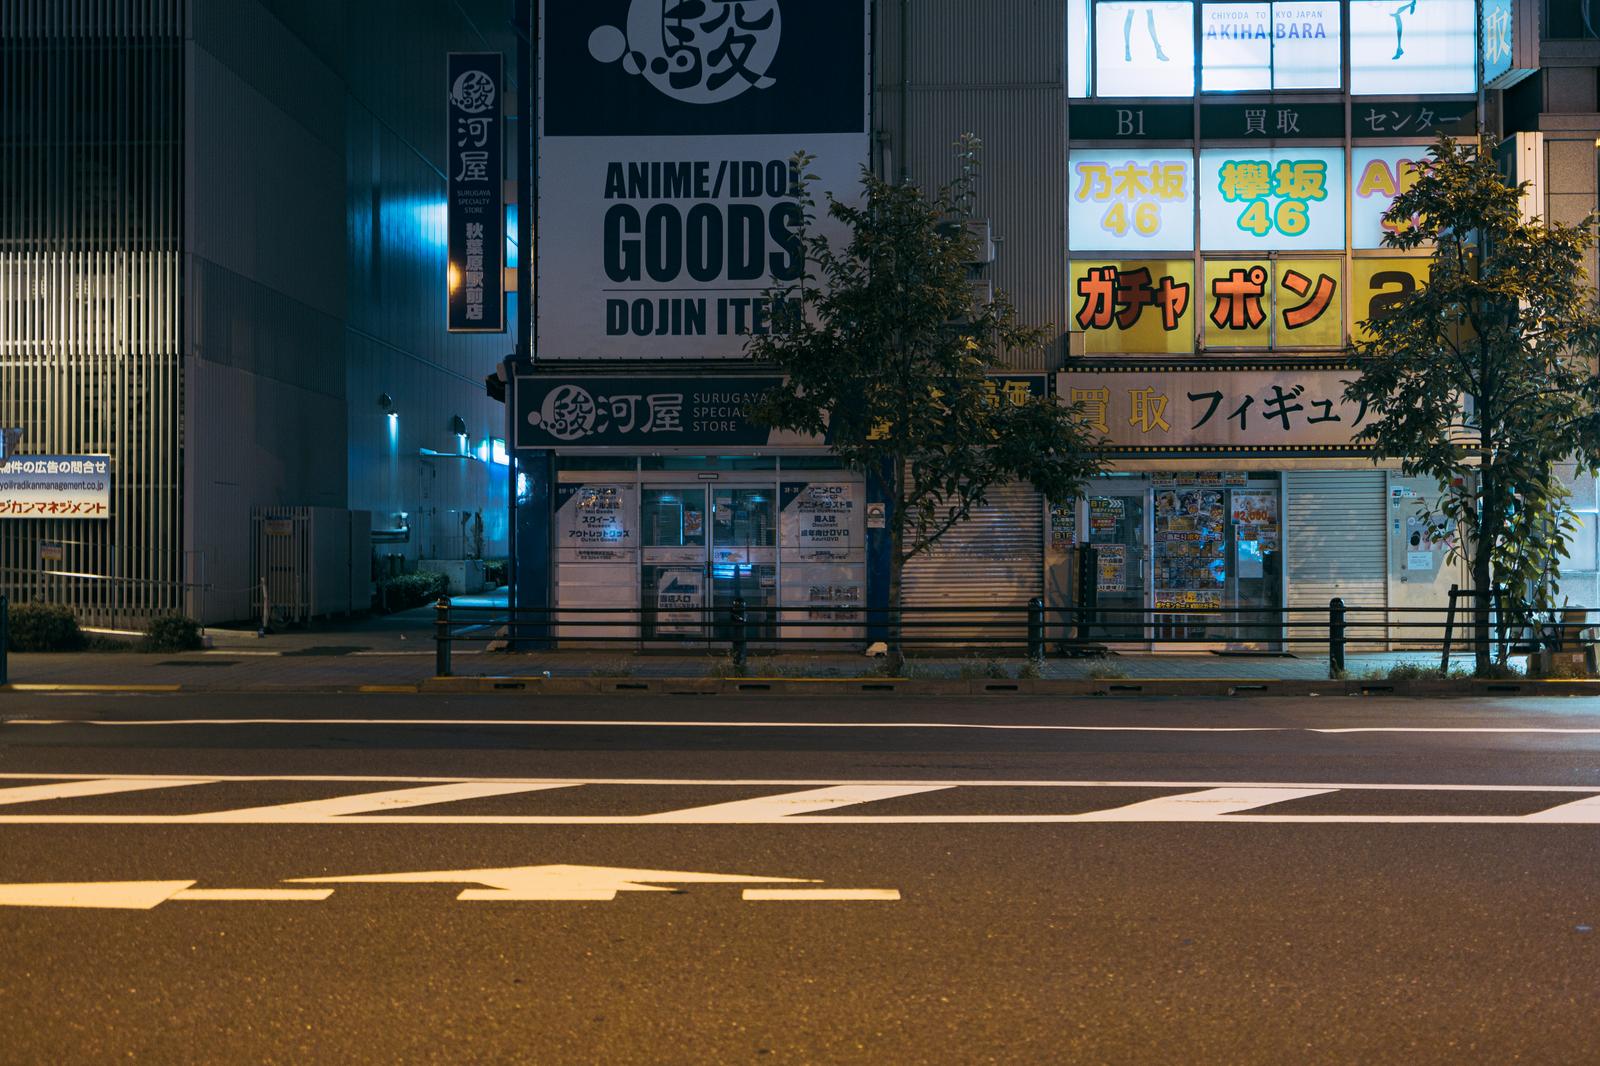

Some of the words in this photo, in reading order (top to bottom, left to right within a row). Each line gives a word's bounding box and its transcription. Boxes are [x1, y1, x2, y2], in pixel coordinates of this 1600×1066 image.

[1211, 11, 1249, 20] CHIYODA
[1296, 10, 1323, 19] JAPAN
[1116, 109, 1147, 136] B1
[1243, 108, 1300, 135] 買取
[1364, 107, 1462, 132] センター
[1075, 160, 1188, 202] 乃木坂
[1100, 200, 1162, 238] 46
[1237, 199, 1310, 238] 46
[603, 202, 805, 283] GOODS
[606, 298, 706, 336] DOJIN
[528, 384, 684, 441] 駿河屋
[693, 392, 769, 404] SURUGAYA
[693, 407, 750, 418] SPECIAL
[693, 421, 737, 432] STORE
